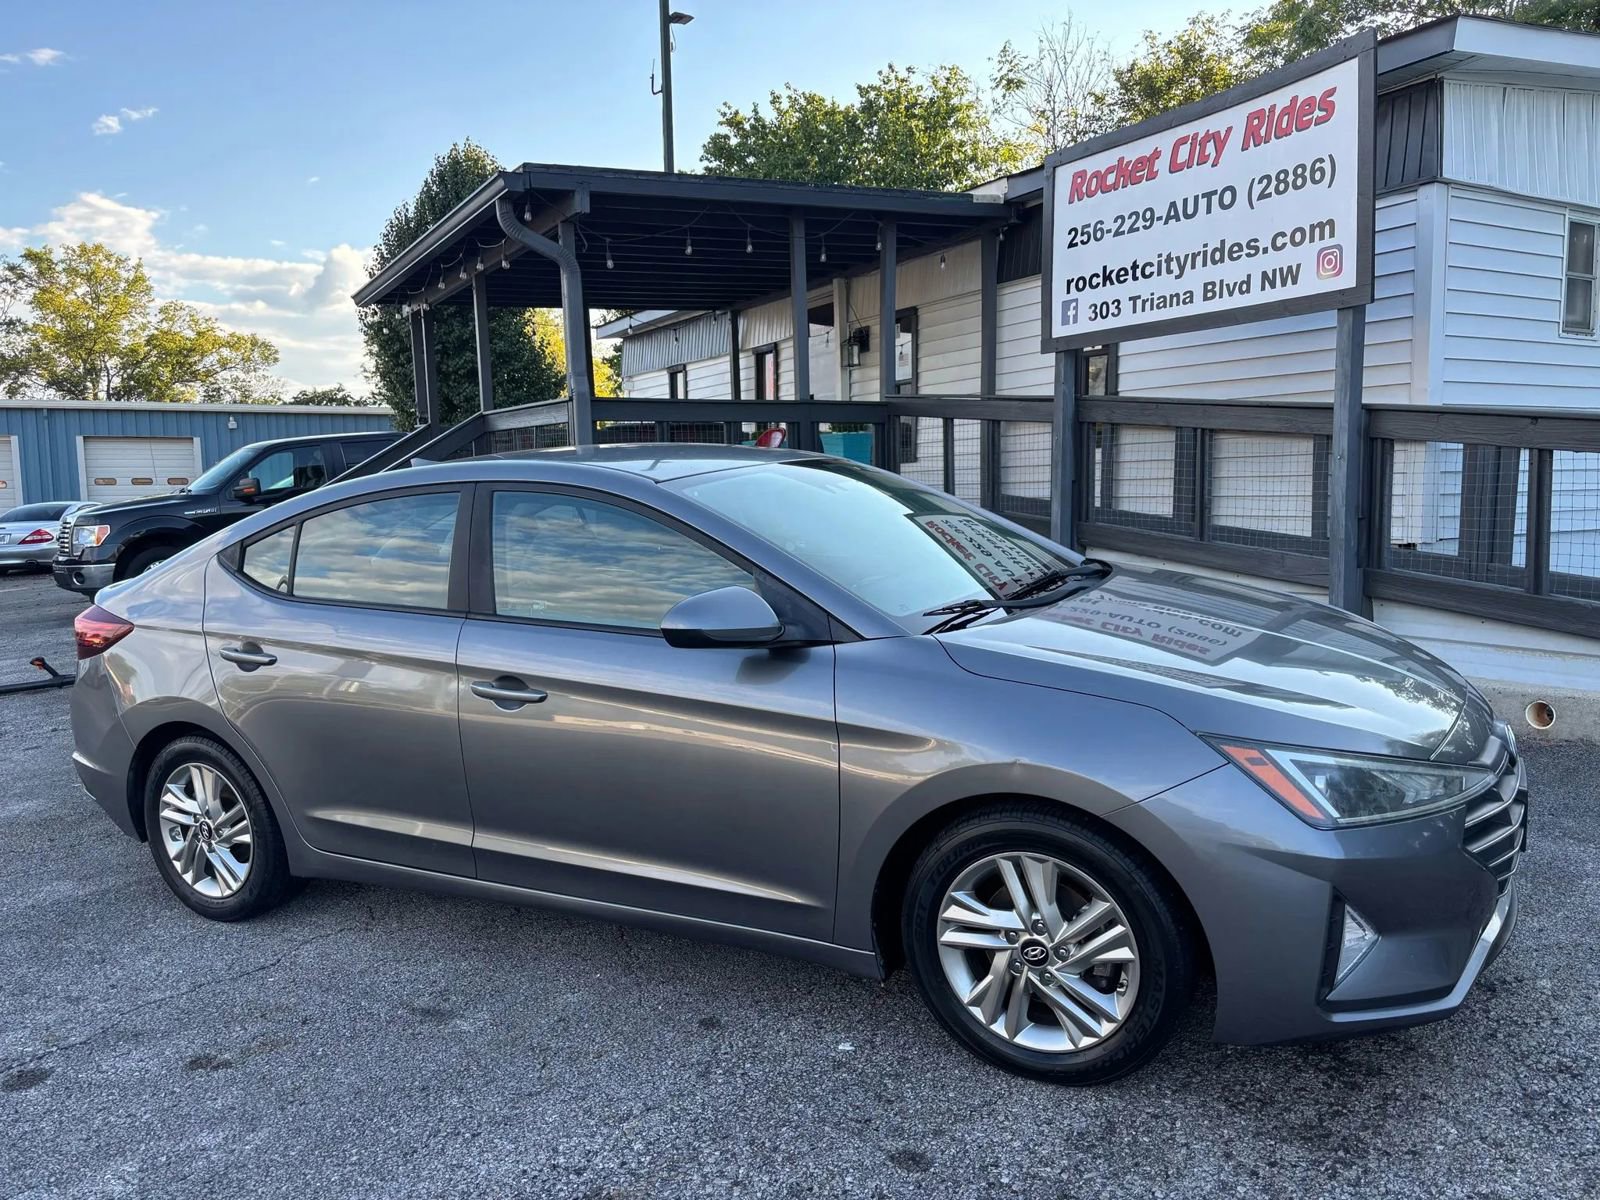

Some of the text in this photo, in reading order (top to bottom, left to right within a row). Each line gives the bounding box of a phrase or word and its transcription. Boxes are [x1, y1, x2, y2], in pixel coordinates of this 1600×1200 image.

[1068, 86, 1337, 204] Rocket City Rides
[1067, 153, 1337, 249] 256-229-AUTO (2886)
[1065, 218, 1336, 294] rocketcityrides.com
[1088, 262, 1302, 322] 303 Triana Blvd NW
